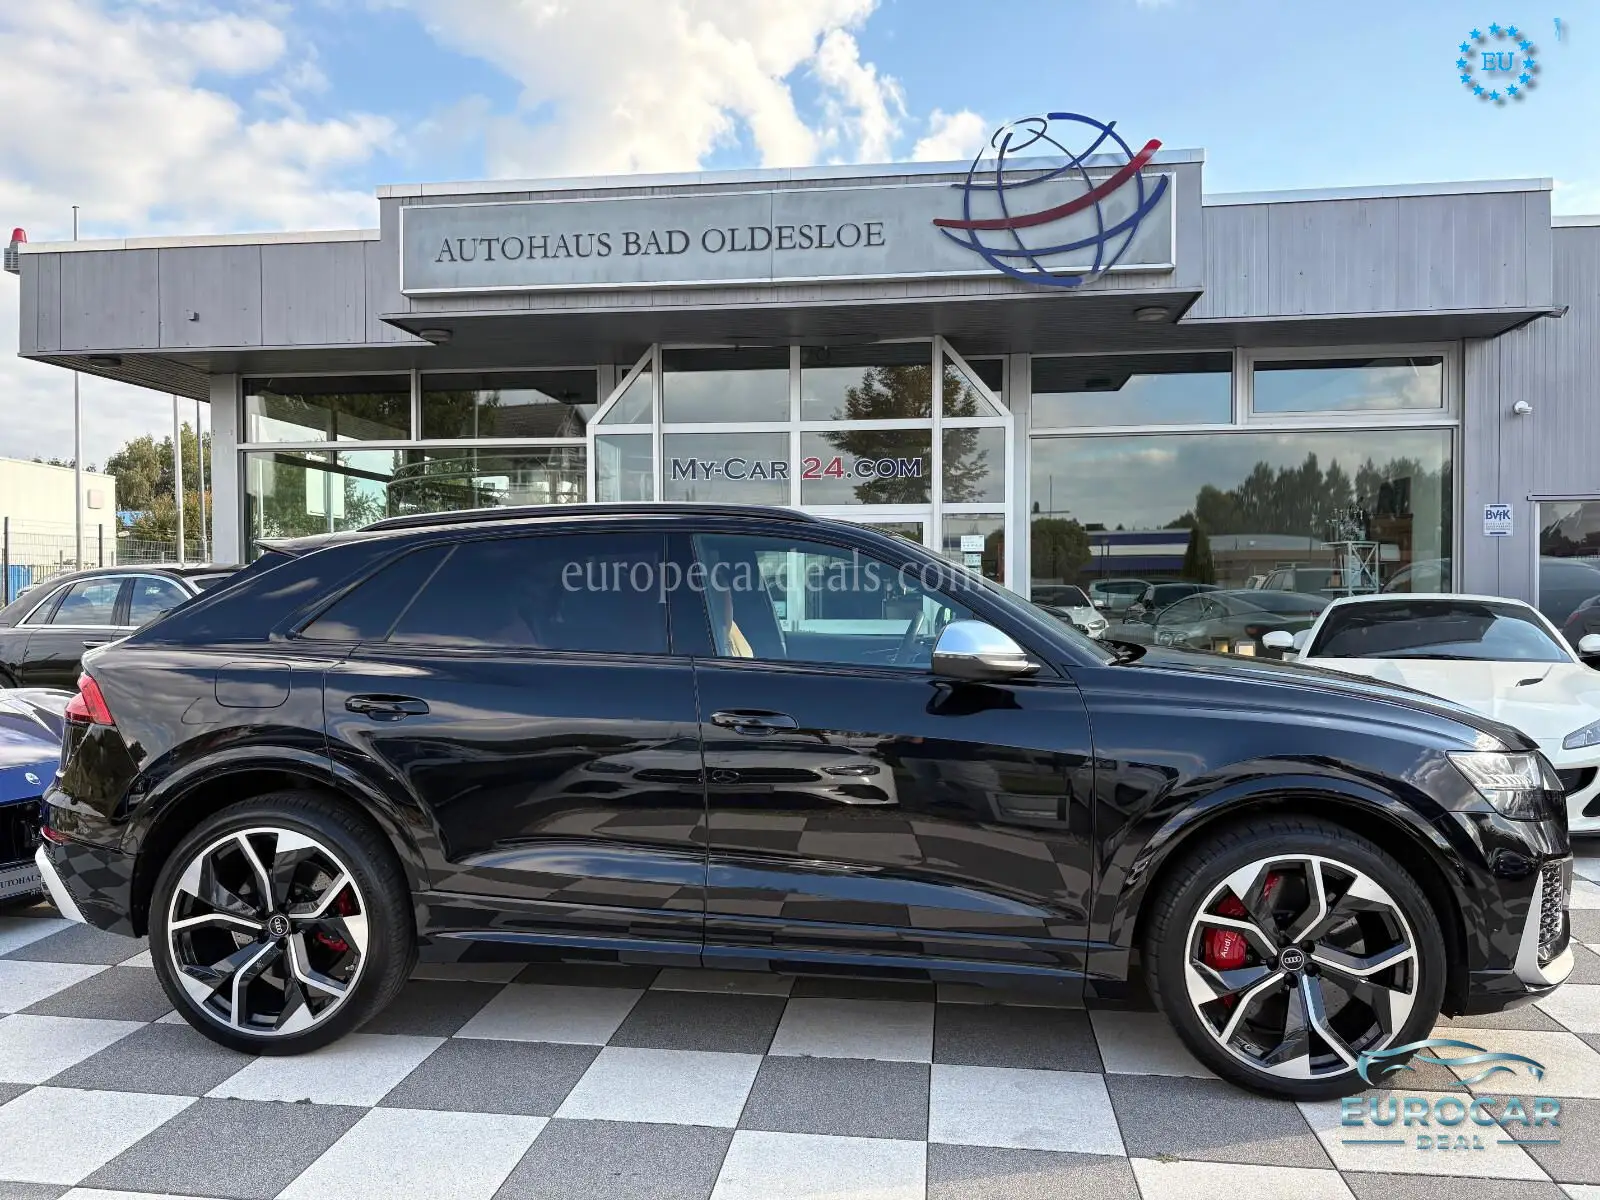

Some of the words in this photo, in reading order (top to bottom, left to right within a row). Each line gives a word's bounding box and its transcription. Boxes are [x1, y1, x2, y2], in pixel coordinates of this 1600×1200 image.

[434, 233, 612, 264] AUTOHAUS
[622, 229, 690, 256] BAD
[701, 221, 887, 254] OLDESLOE
[1221, 938, 1232, 958] Audi
